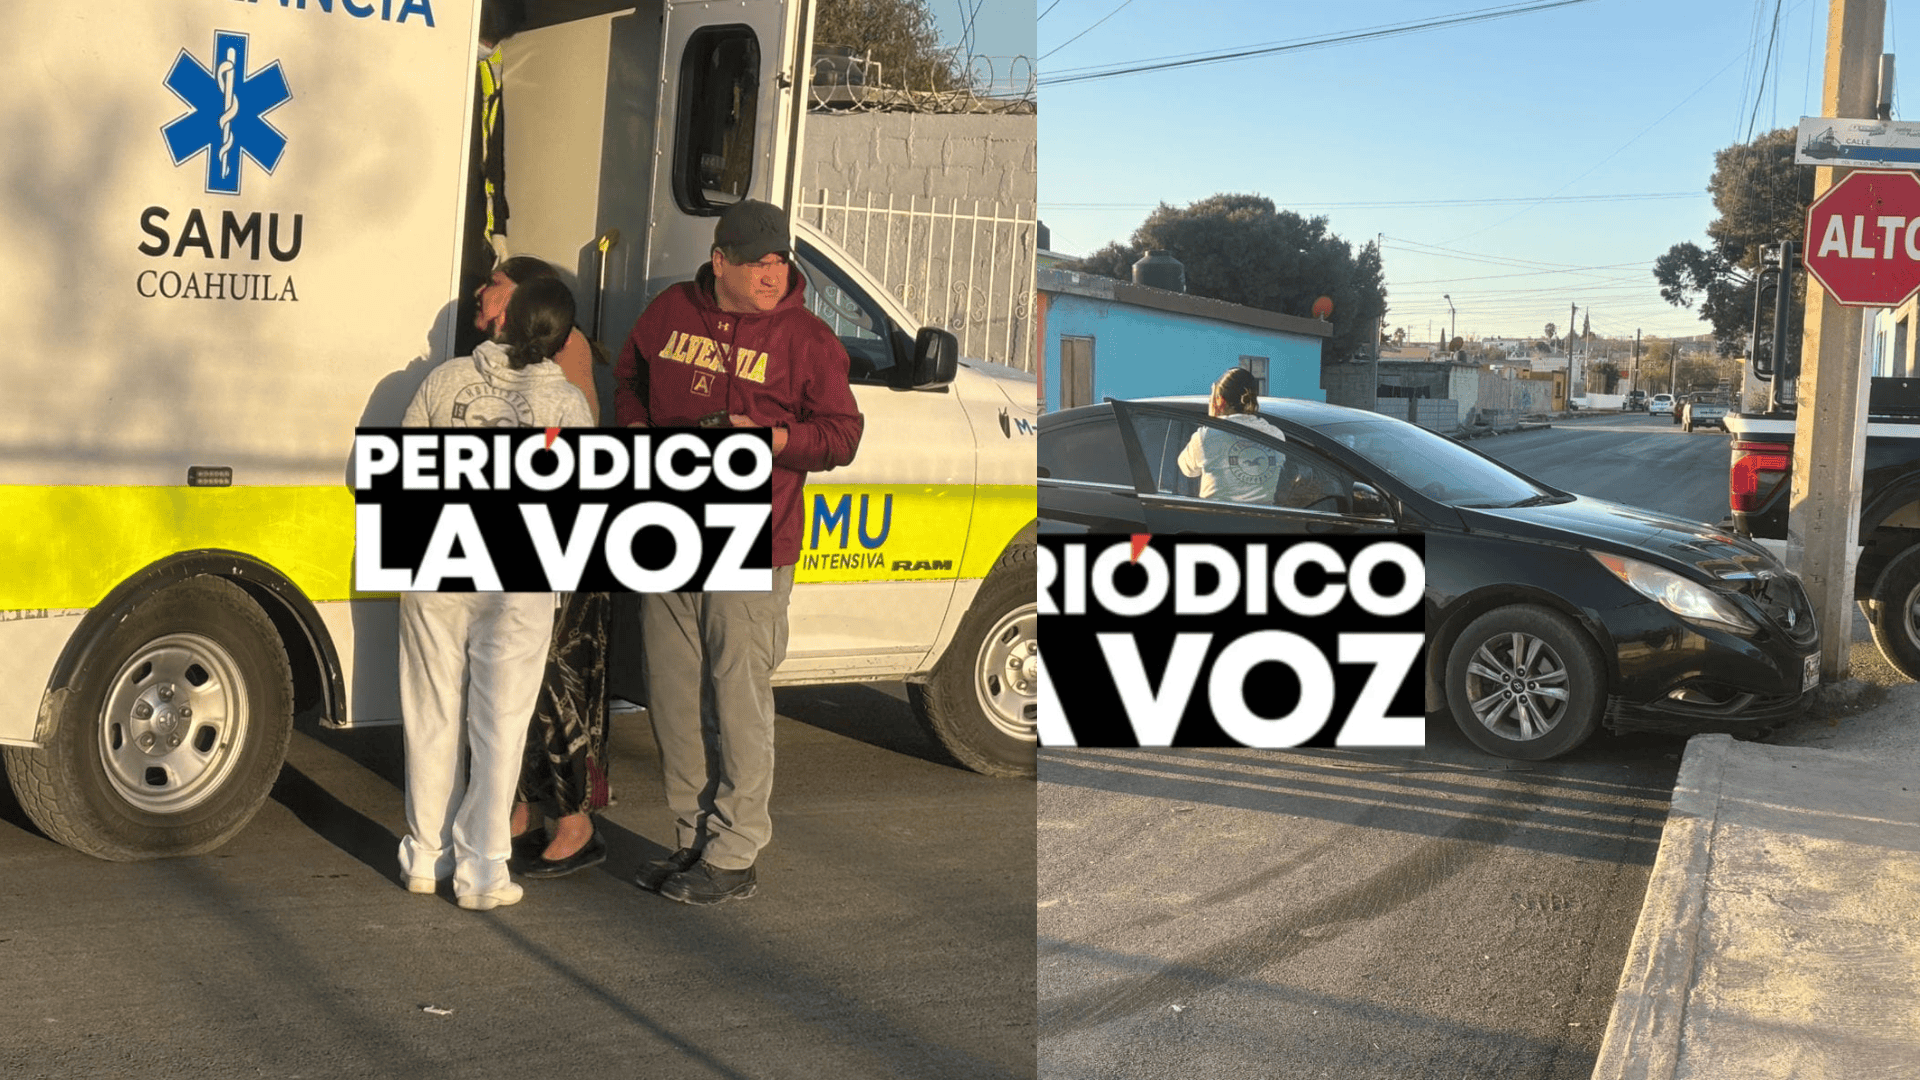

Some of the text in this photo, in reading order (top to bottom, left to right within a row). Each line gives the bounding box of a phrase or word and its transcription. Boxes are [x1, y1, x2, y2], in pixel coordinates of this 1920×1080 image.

[137, 206, 304, 262] SAMU
[137, 270, 299, 302] COAHUILA
[802, 552, 886, 571] INTENSIVA
[891, 560, 953, 572] RAM
